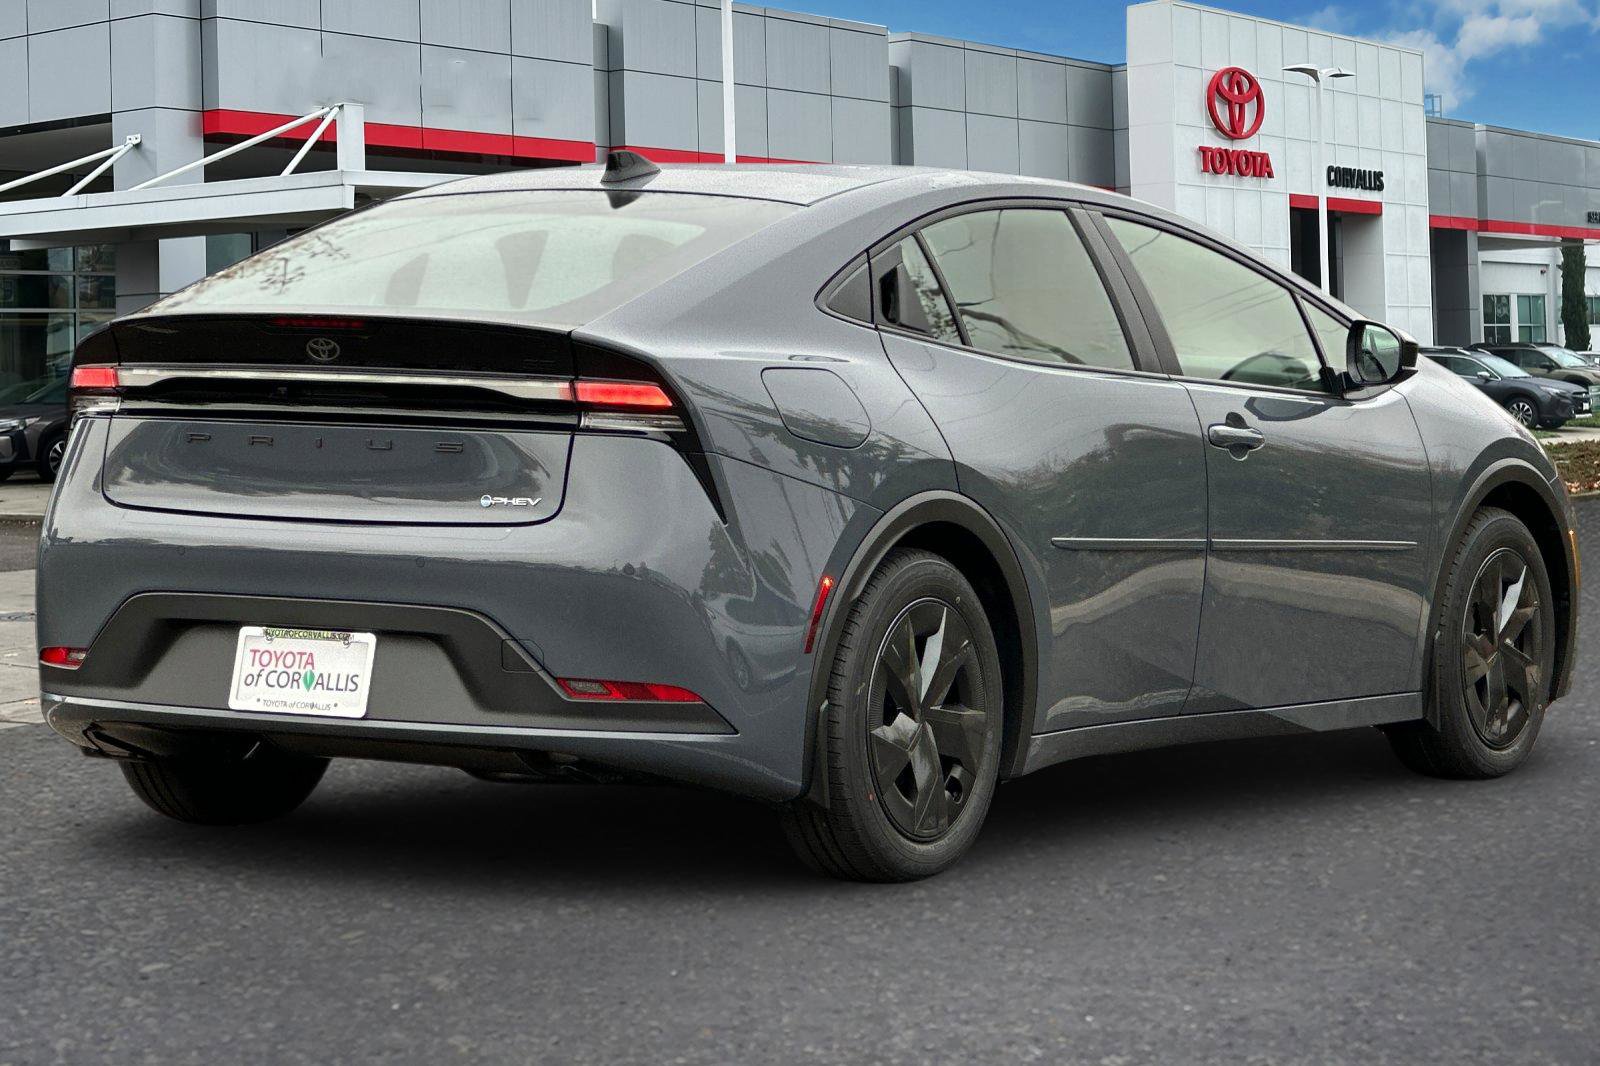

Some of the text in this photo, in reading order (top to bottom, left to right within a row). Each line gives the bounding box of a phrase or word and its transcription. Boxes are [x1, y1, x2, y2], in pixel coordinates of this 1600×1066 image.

[1198, 145, 1274, 178] TOYOTA
[1327, 165, 1384, 191] CORVALLIS
[187, 433, 463, 453] PRIUS
[249, 649, 315, 670] TOYOTA
[244, 669, 265, 687] of
[263, 699, 287, 708] TOYOTA
